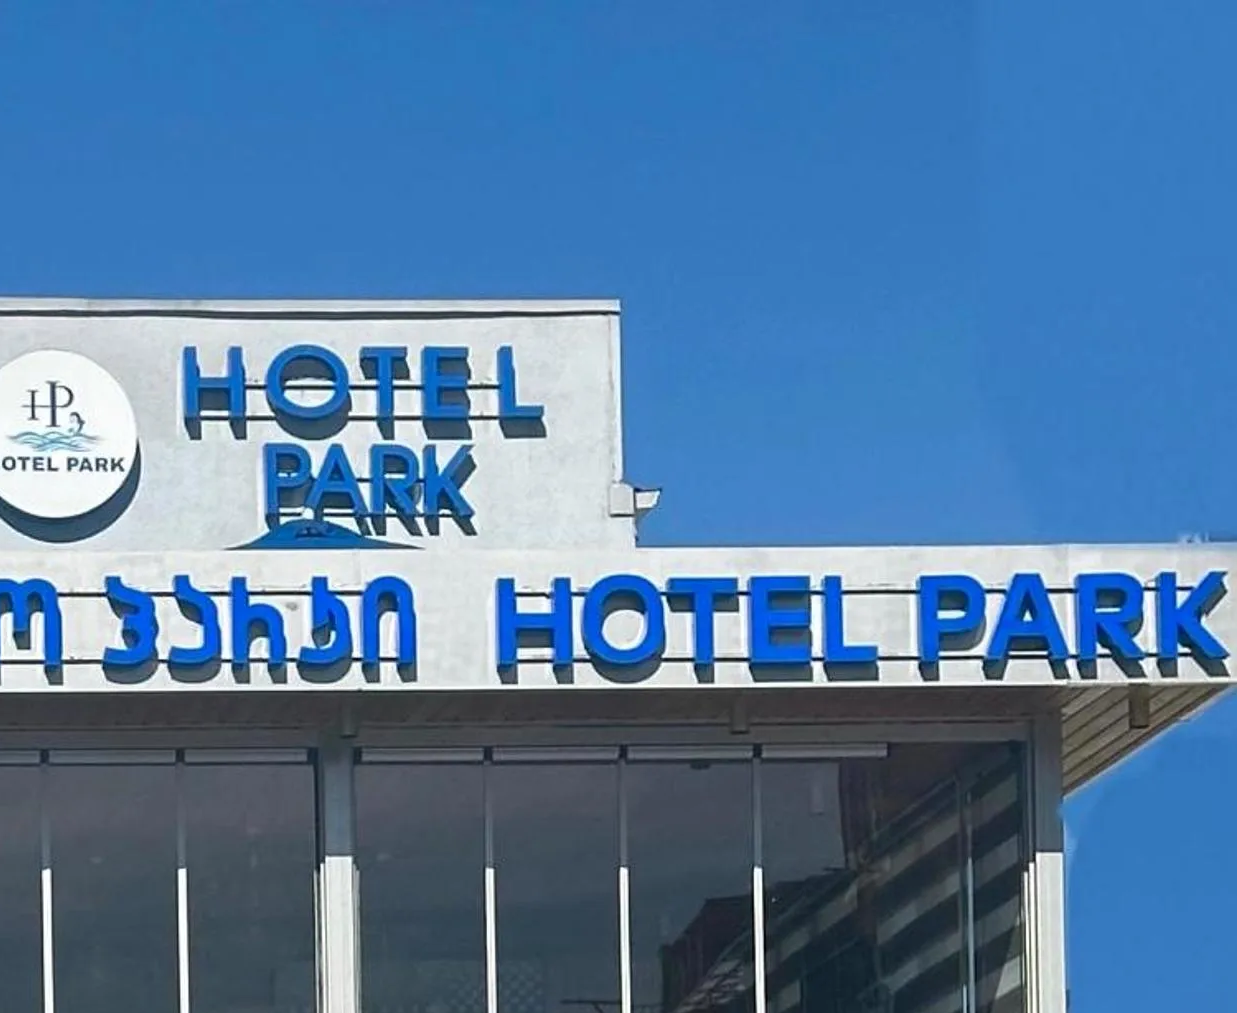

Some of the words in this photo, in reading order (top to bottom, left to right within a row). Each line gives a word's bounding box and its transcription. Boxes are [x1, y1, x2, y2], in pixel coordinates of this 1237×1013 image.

[182, 345, 544, 421] HOTEL
[66, 457, 125, 473] PARK
[265, 443, 476, 518] PARK
[103, 575, 417, 667] პარკი
[495, 573, 879, 668] HOTEL
[916, 571, 1229, 665] PARK
